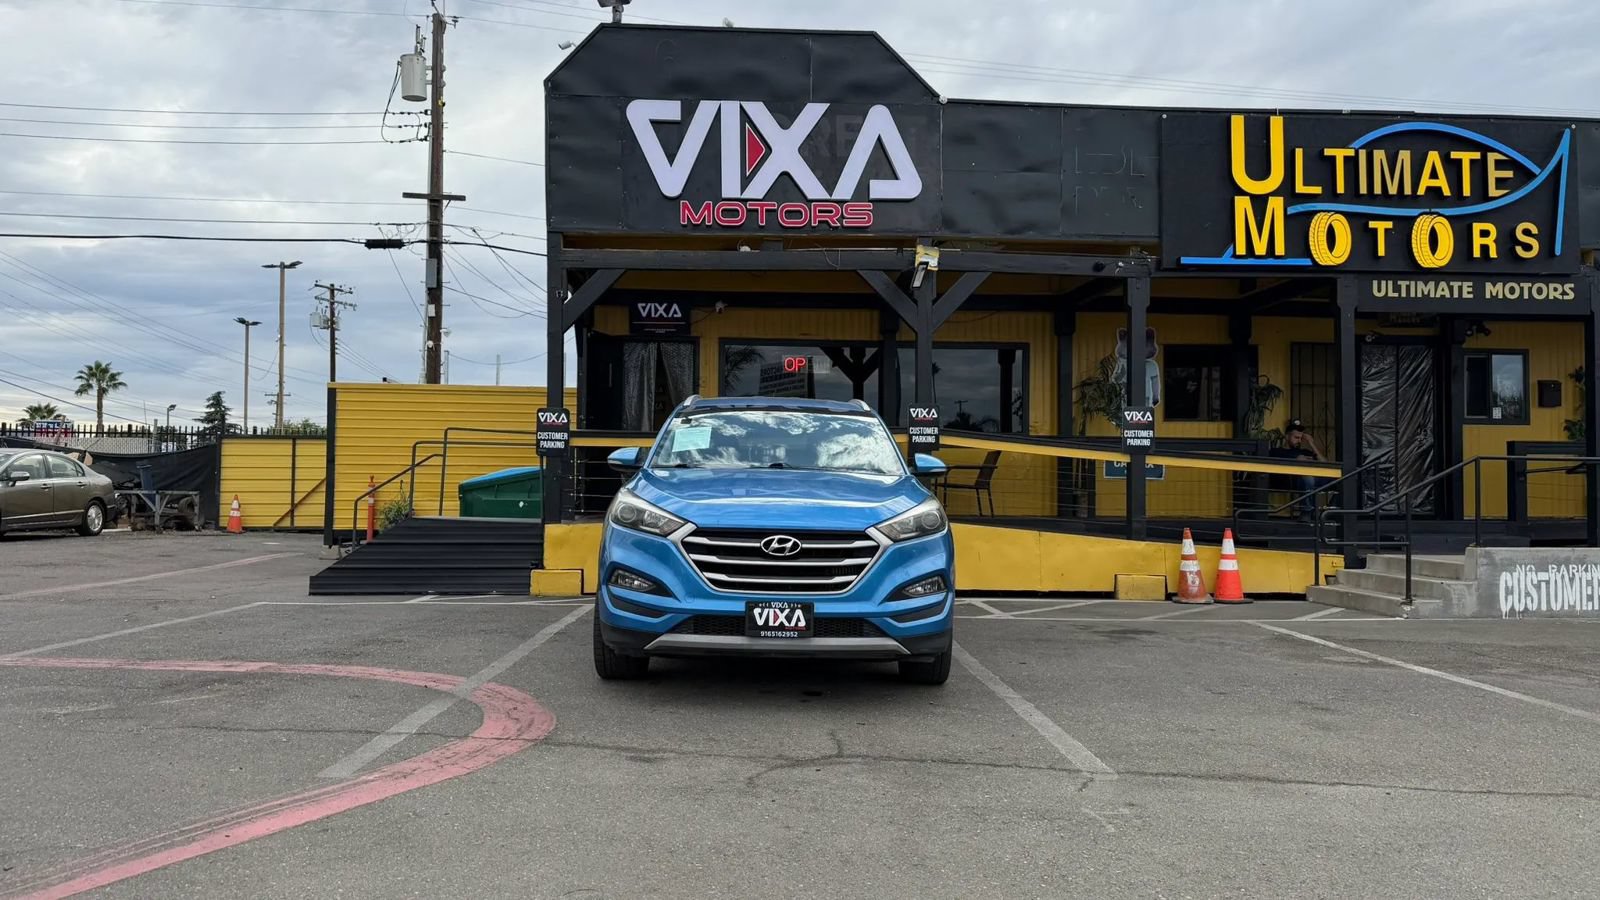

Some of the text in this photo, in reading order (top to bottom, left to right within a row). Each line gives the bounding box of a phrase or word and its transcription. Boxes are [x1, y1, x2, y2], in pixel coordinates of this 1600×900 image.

[626, 99, 923, 199] VIXA
[1230, 114, 1515, 198] ULTIMATE
[680, 200, 874, 227] MOTORS
[1233, 196, 1541, 269] MOTORS
[1372, 280, 1576, 301] ULTIMATE MOTORS
[637, 303, 682, 318] VIXA
[538, 412, 568, 423] VIXA
[910, 408, 938, 418] VIXA
[1124, 411, 1153, 422] VIXA
[537, 431, 568, 440] CUSTOMER
[909, 427, 939, 435] CUSTOMER
[1123, 430, 1154, 438] CUSTOMER
[539, 441, 565, 449] PARKING
[1515, 564, 1537, 578] NO
[771, 601, 789, 609] VIXA
[753, 607, 806, 627] VIXA
